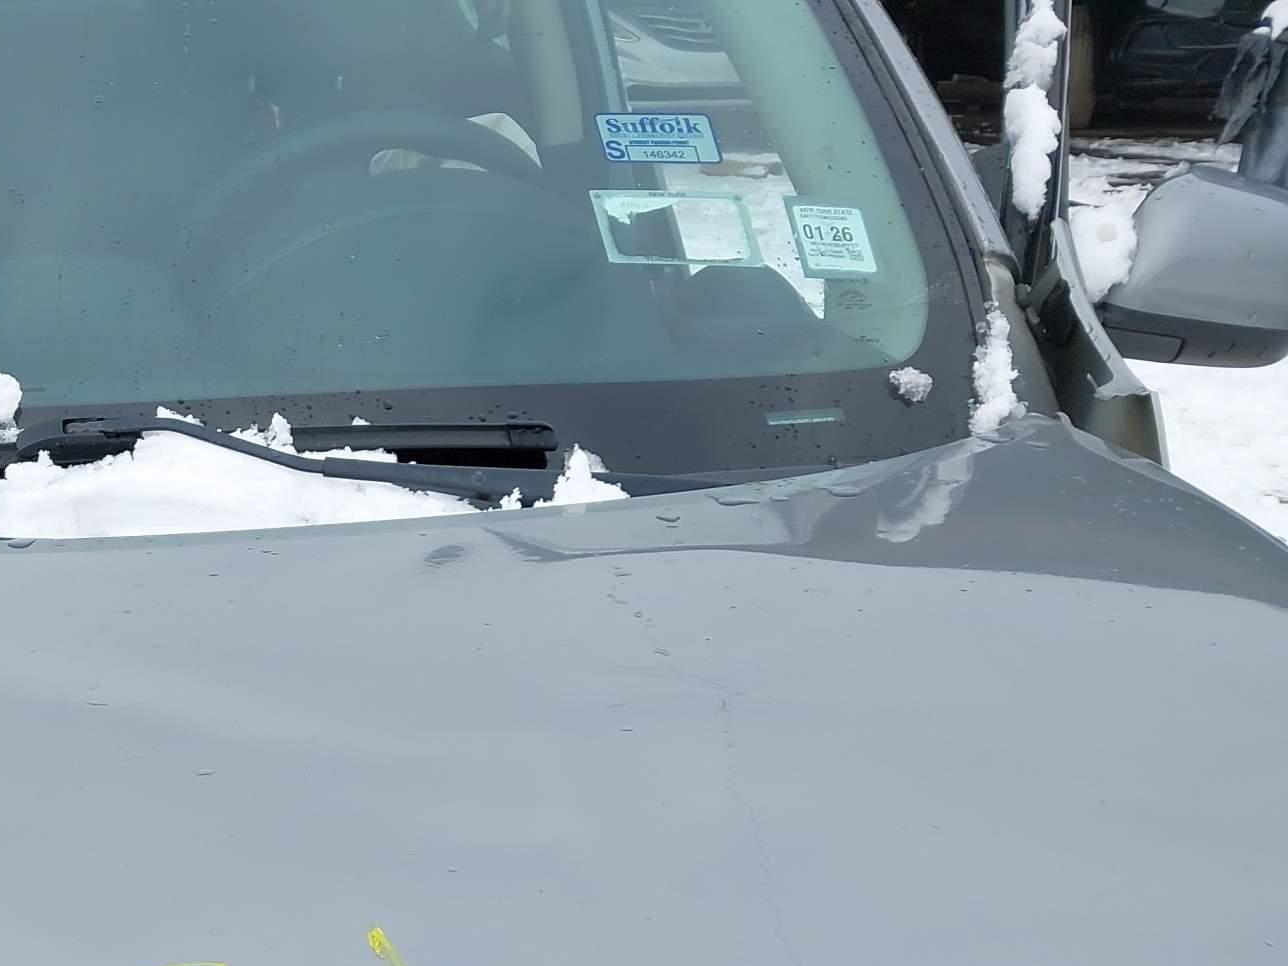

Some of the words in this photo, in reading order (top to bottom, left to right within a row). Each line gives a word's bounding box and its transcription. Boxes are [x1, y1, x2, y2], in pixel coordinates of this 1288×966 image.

[605, 140, 626, 160] S
[642, 150, 686, 160] 146342
[803, 224, 824, 241] 01
[830, 226, 854, 242] 26
